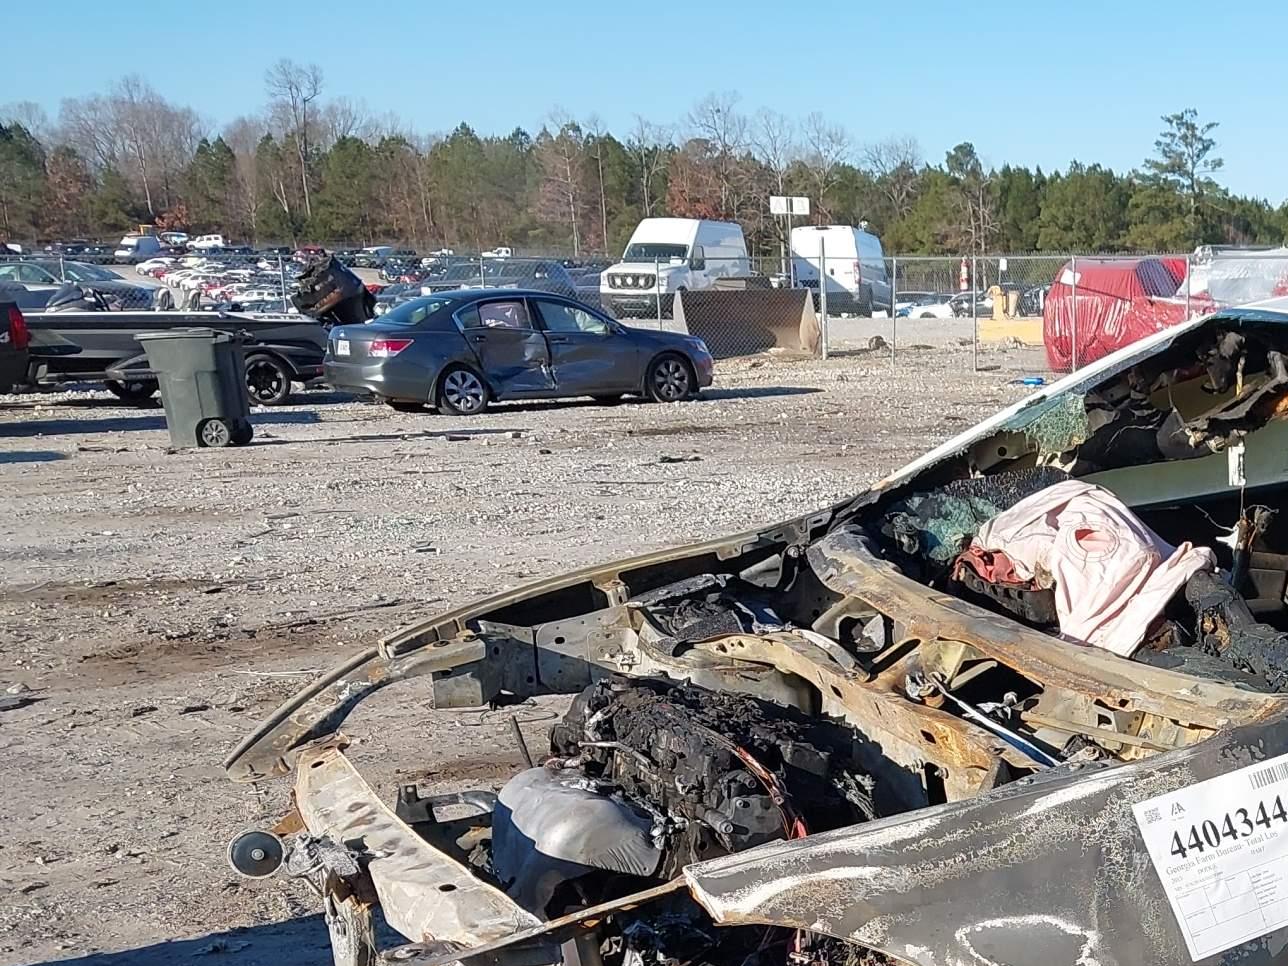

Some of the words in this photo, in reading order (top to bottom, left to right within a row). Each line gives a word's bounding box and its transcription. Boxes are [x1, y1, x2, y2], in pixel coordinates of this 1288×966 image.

[1166, 859, 1196, 876] Georgia
[1195, 853, 1216, 865] Farm
[1243, 834, 1264, 847] Total
